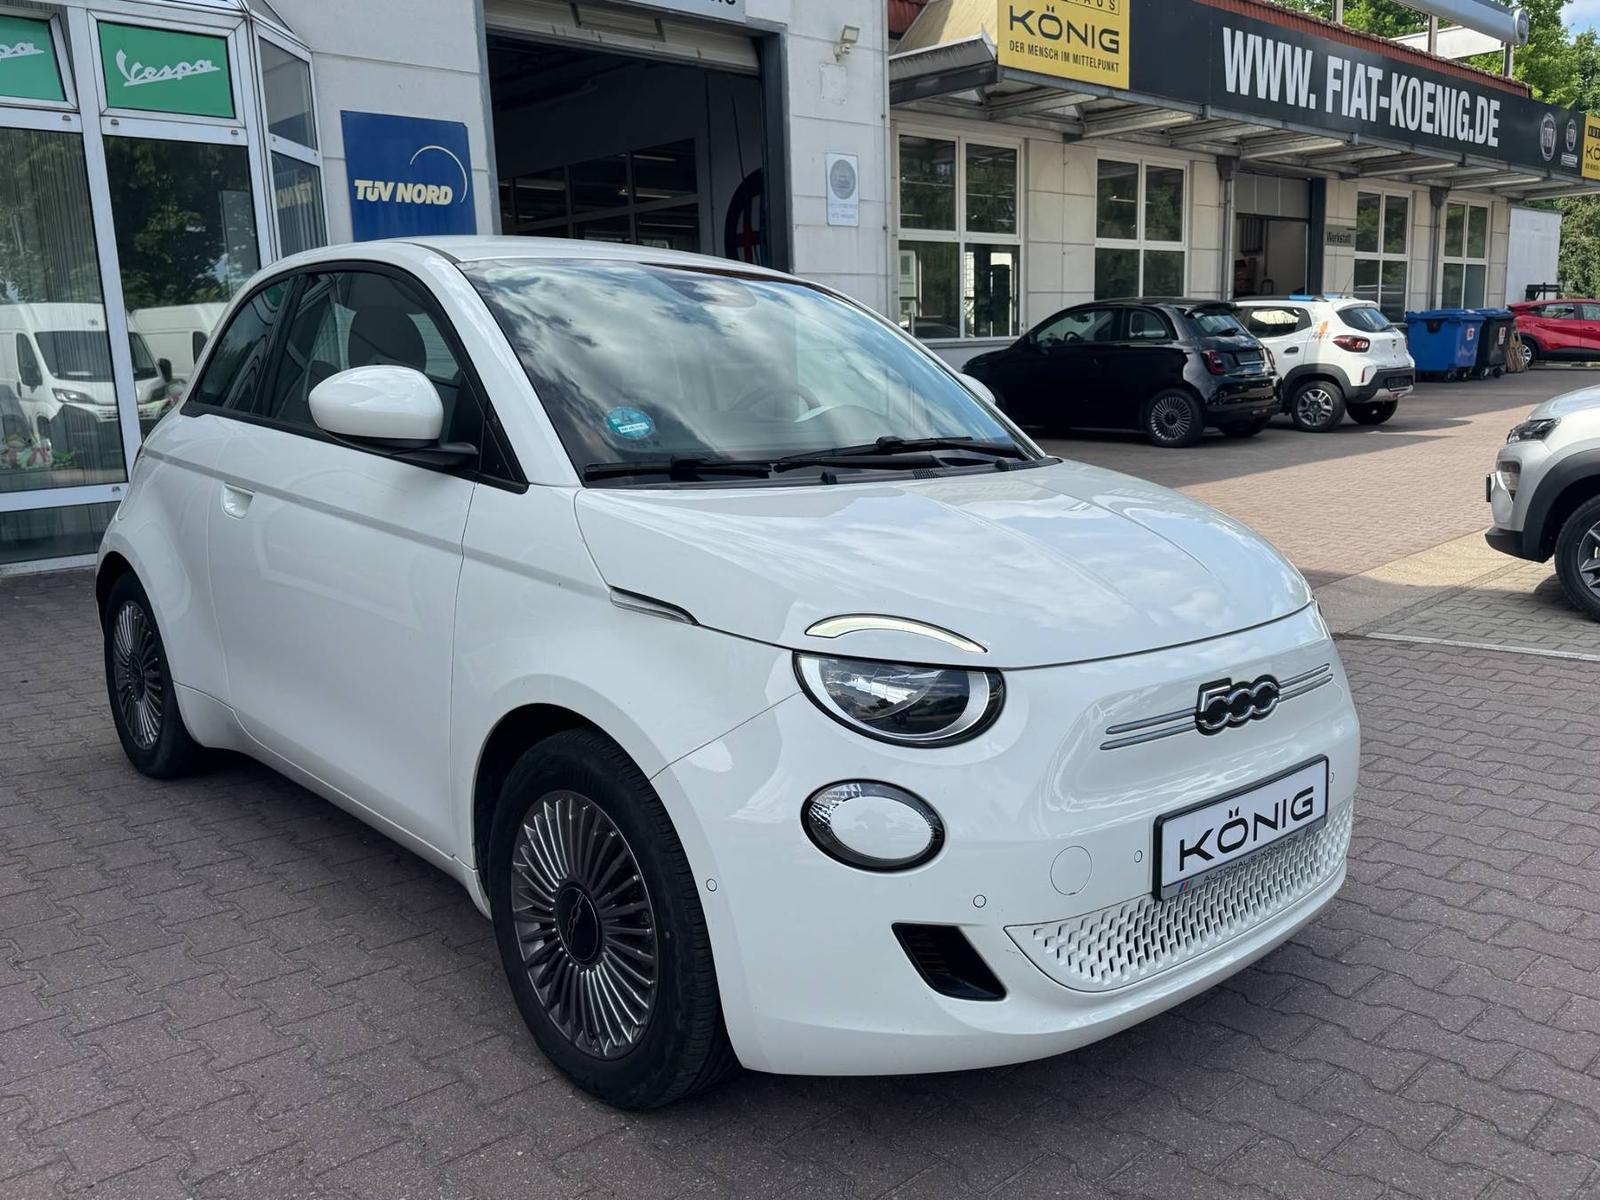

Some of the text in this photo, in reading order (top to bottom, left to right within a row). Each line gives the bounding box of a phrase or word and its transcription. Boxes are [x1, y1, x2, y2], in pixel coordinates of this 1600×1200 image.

[1009, 4, 1120, 54] KÖNIG
[115, 49, 221, 87] Vespa
[1009, 40, 1120, 73] DER MENSCH IM MITTELPUNKT
[1222, 26, 1501, 148] WWW. FIAT-KOENIG.DE
[354, 179, 453, 205] TÜV NORD
[1196, 676, 1279, 735] 500
[1179, 786, 1314, 872] KÖNIG
